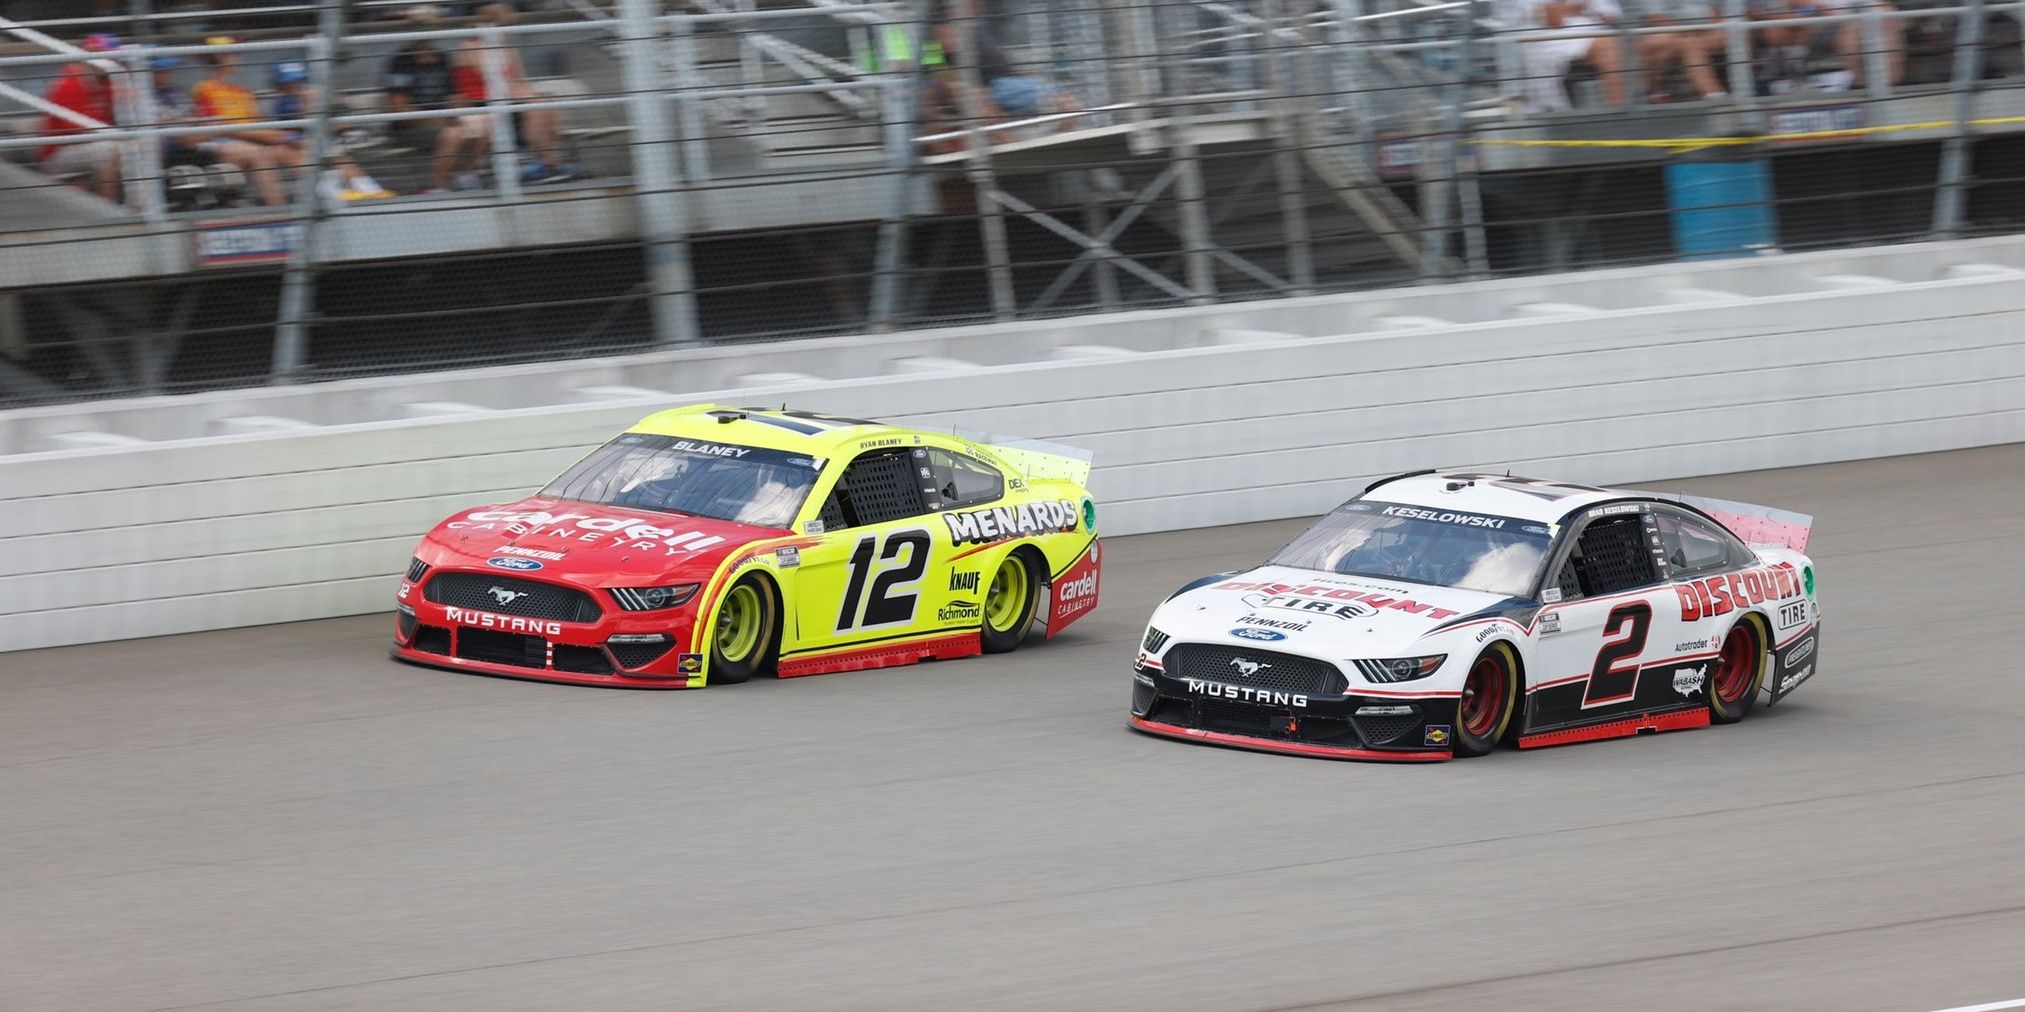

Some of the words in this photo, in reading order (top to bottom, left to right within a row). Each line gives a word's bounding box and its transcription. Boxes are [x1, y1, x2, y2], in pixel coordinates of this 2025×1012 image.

[672, 440, 751, 459] BLANEY
[943, 499, 1078, 547] MENARDS
[1382, 505, 1506, 529] KESELOWSKI
[446, 521, 687, 556] CABINETRY
[467, 511, 727, 551] cardell
[493, 545, 566, 561] PENNZOIL
[495, 558, 535, 569] Ford
[398, 583, 410, 599] 12
[835, 527, 932, 633] 12
[949, 566, 980, 595] KNAUF
[1060, 569, 1097, 602] cardell
[1673, 562, 1801, 622] DISCOUNT
[938, 603, 980, 621] Richmond
[1057, 597, 1095, 615] CABINETRY
[1212, 582, 1460, 620] DISCOUNT
[1263, 595, 1365, 621] TIRE
[446, 606, 561, 635] MUSTANG
[1235, 616, 1308, 632] PENNZOIL
[1781, 603, 1806, 627] TIRE
[1238, 629, 1278, 640] Ford
[1675, 639, 1708, 652] Autotrader
[1135, 652, 1147, 671] 2
[1582, 599, 1653, 709] 2
[1189, 680, 1308, 708] MUSTANG
